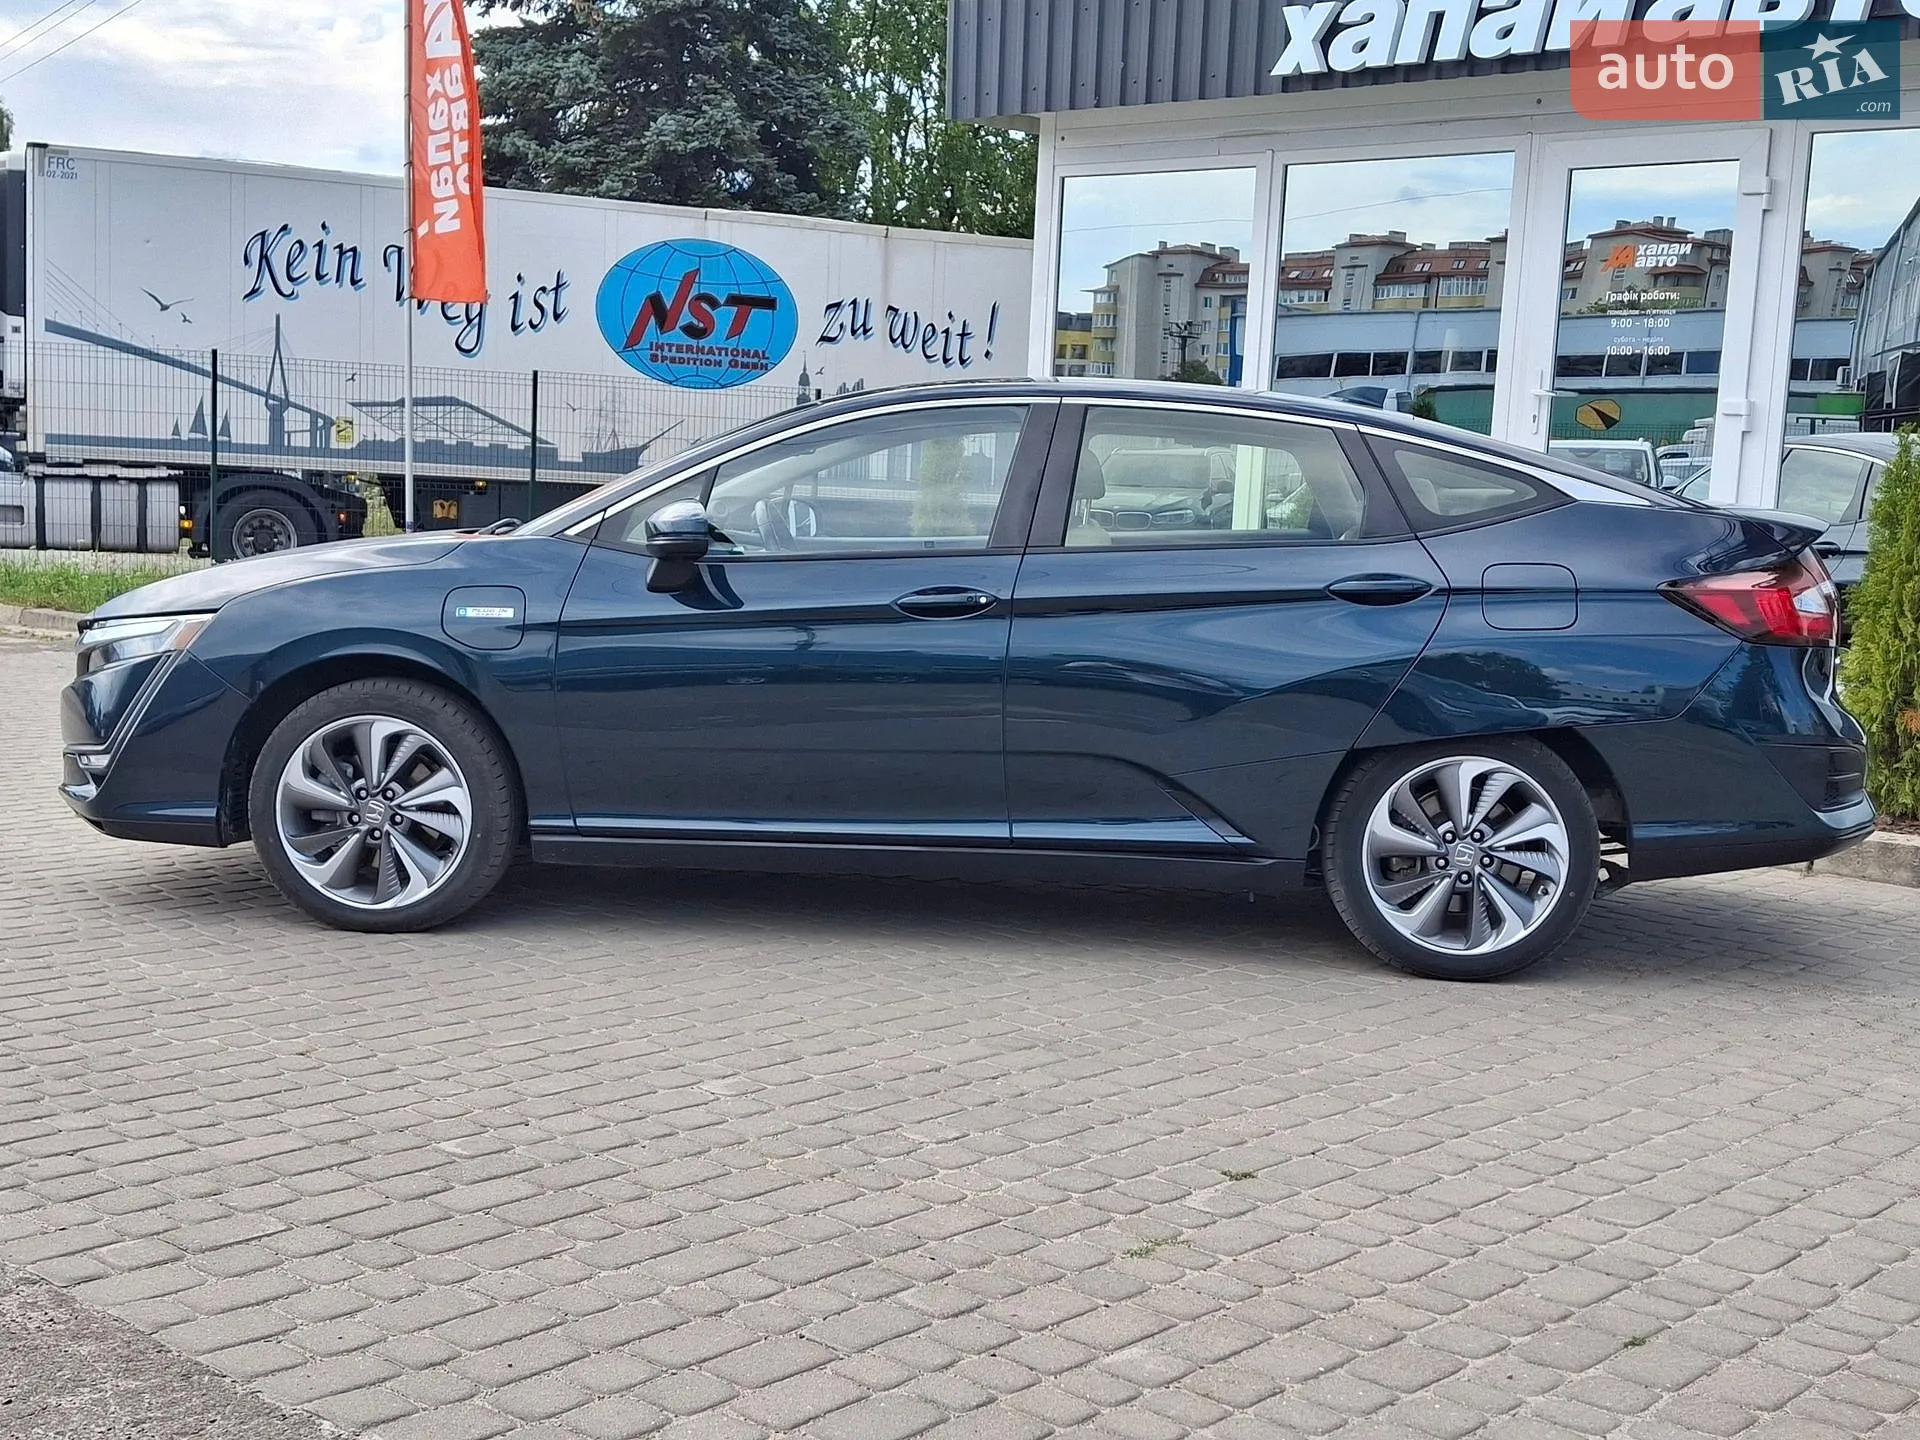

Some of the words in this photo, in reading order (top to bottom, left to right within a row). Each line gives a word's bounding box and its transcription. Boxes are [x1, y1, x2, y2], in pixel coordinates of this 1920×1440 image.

[48, 156, 75, 170] FRC
[46, 170, 78, 180] 02-2021
[1635, 256, 1678, 268] авто
[242, 221, 366, 301] Kein
[508, 269, 569, 335] ist
[815, 297, 873, 346] zu
[1606, 290, 1638, 303] Графік
[1640, 290, 1680, 303] роботи:
[622, 268, 777, 350] NST
[1611, 318, 1632, 328] 9:00
[1643, 318, 1670, 328] 18:00
[649, 341, 769, 360] INTERNATIONAL
[1606, 345, 1632, 355] 10:00
[1643, 345, 1670, 355] 16:00
[649, 353, 722, 368] SPEDITION
